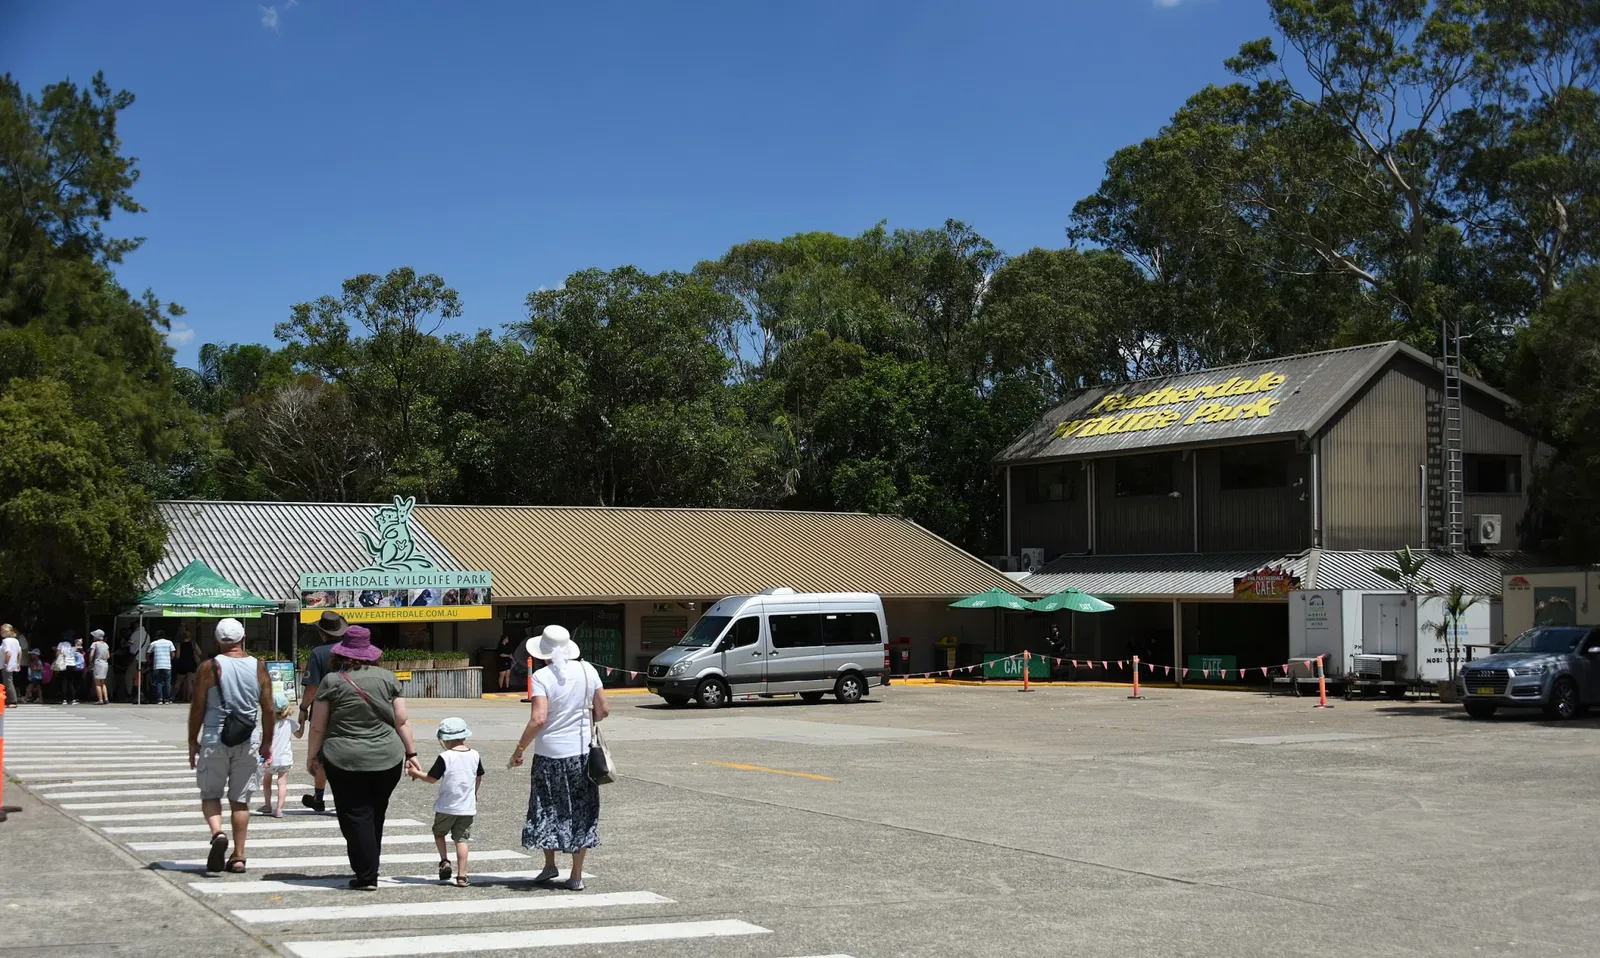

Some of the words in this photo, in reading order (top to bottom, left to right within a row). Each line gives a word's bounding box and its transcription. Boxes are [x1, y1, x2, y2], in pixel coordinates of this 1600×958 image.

[1091, 371, 1286, 414] Featherdale
[1050, 409, 1181, 439] Wildlife
[1183, 397, 1280, 426] Park
[306, 576, 389, 587] FEATHERDALE
[395, 575, 450, 586] WILDLIFE
[457, 574, 487, 584] PARK
[1004, 660, 1029, 674] CAF
